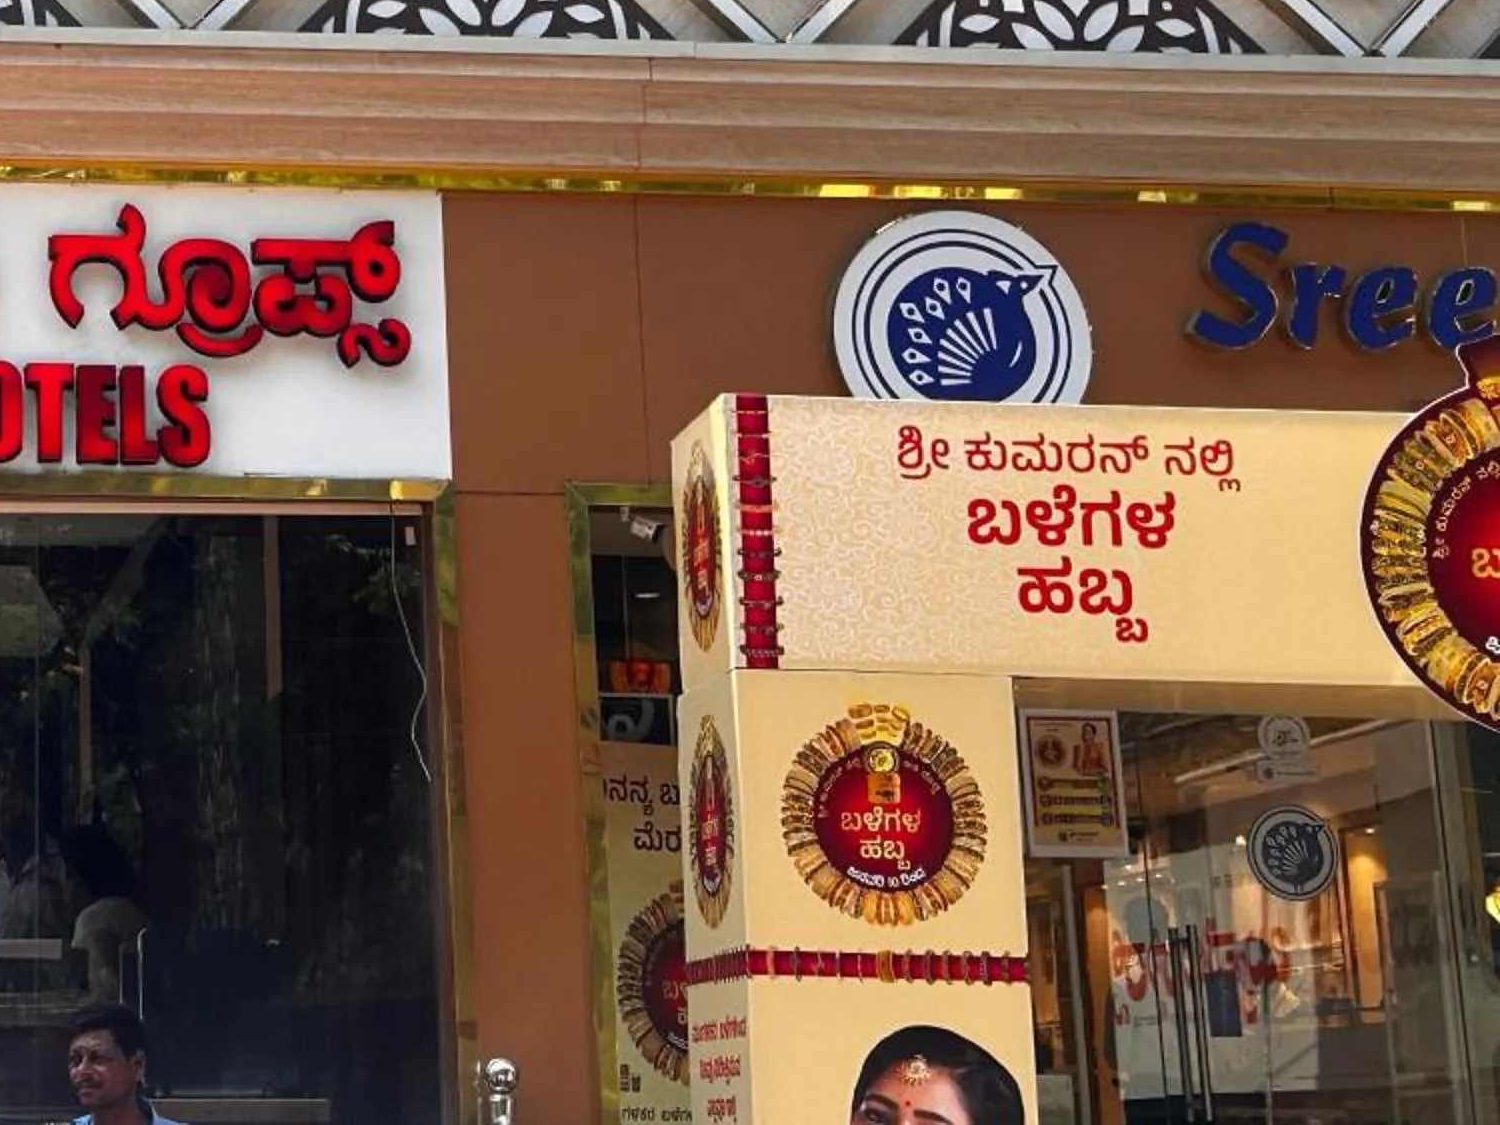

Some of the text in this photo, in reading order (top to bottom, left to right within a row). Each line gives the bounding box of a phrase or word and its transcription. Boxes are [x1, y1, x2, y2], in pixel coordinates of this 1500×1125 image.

[48, 203, 411, 368] ಗ್ರೂಪ್ಸ್
[1186, 220, 1498, 351] Sree
[898, 425, 1241, 492] ಶ್ರೀ ಕುಮರನ್ ನಲ್ಲಿ
[967, 484, 1177, 550] ಬಳೆಗಳ
[1016, 556, 1149, 643] ಹಬ್ಬ
[841, 806, 922, 833] ಬಳೆಗಳ
[860, 834, 911, 870] ಹಬ್ಬ
